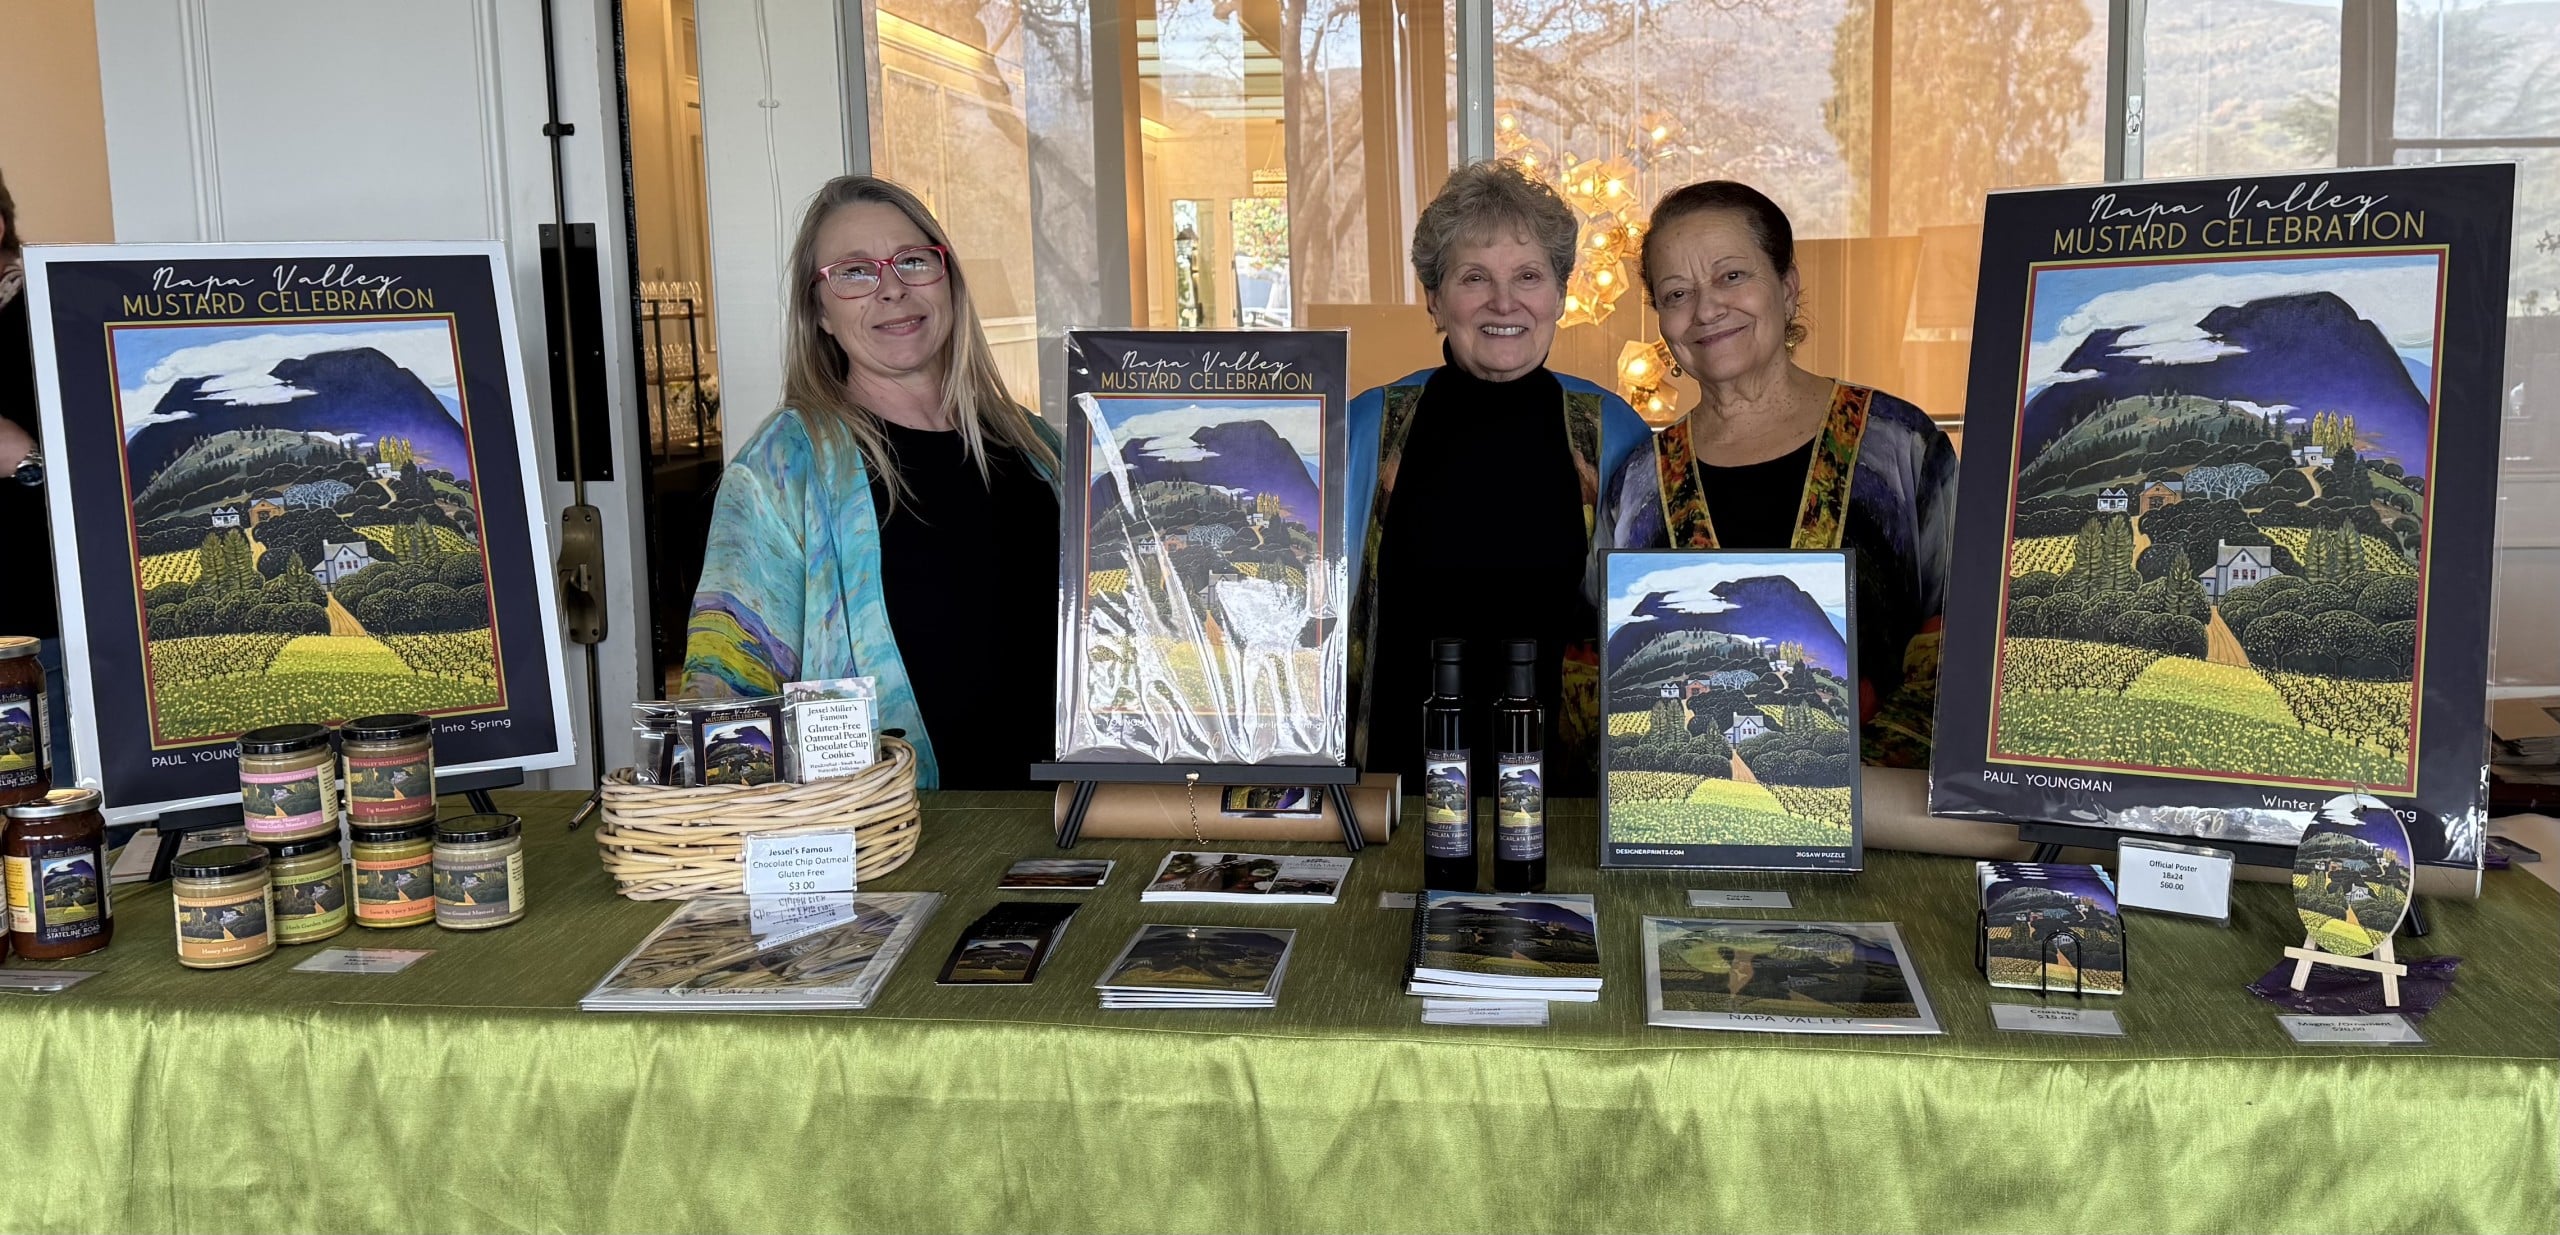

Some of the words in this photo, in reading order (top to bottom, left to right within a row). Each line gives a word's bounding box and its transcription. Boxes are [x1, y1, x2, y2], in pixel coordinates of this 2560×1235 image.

[2089, 192, 2203, 233] Napa
[2227, 180, 2389, 226] Valley
[2053, 222, 2187, 255] MUSTARD
[2202, 211, 2425, 248] CELEBRATION
[153, 266, 255, 300] Napa
[273, 263, 402, 299] Valley
[123, 291, 245, 316] MUSTARD
[257, 288, 434, 313] CELEBRATION
[1121, 350, 1190, 377] Napa
[1202, 351, 1293, 381] Valley
[1101, 372, 1182, 390] MUSTARD
[1189, 372, 1313, 391] CELEBRATION
[442, 723, 465, 735] Into
[471, 718, 511, 732] Spring
[808, 723, 861, 733] Gluten-Free
[804, 732, 842, 743] Oatmeal
[844, 731, 867, 740] Pecan
[806, 742, 848, 752] Chocolate
[849, 740, 868, 750] Chip
[152, 754, 188, 767] PAUL
[192, 748, 241, 763] YOUNG
[821, 750, 855, 760] Cookies
[1983, 770, 2019, 785] PAUL
[2025, 774, 2113, 793] YOUNGMAN
[2261, 794, 2315, 811] Winter
[769, 847, 800, 857] Jessel's
[802, 846, 833, 854] Famous
[1616, 848, 1685, 856] DESIGNERPRINTS.COM
[753, 859, 793, 869] Chocolate
[795, 858, 813, 866] Chip
[816, 855, 849, 865] Oatmeal
[2149, 860, 2174, 869] Official
[2175, 863, 2198, 872] Poster
[778, 870, 805, 879] Gluten
[2162, 871, 2183, 880] 18x24
[789, 881, 815, 891] $3.00
[2160, 880, 2184, 891] $60.00
[1728, 1013, 1776, 1022] NAPA
[1785, 1016, 1854, 1025] VALLEY
